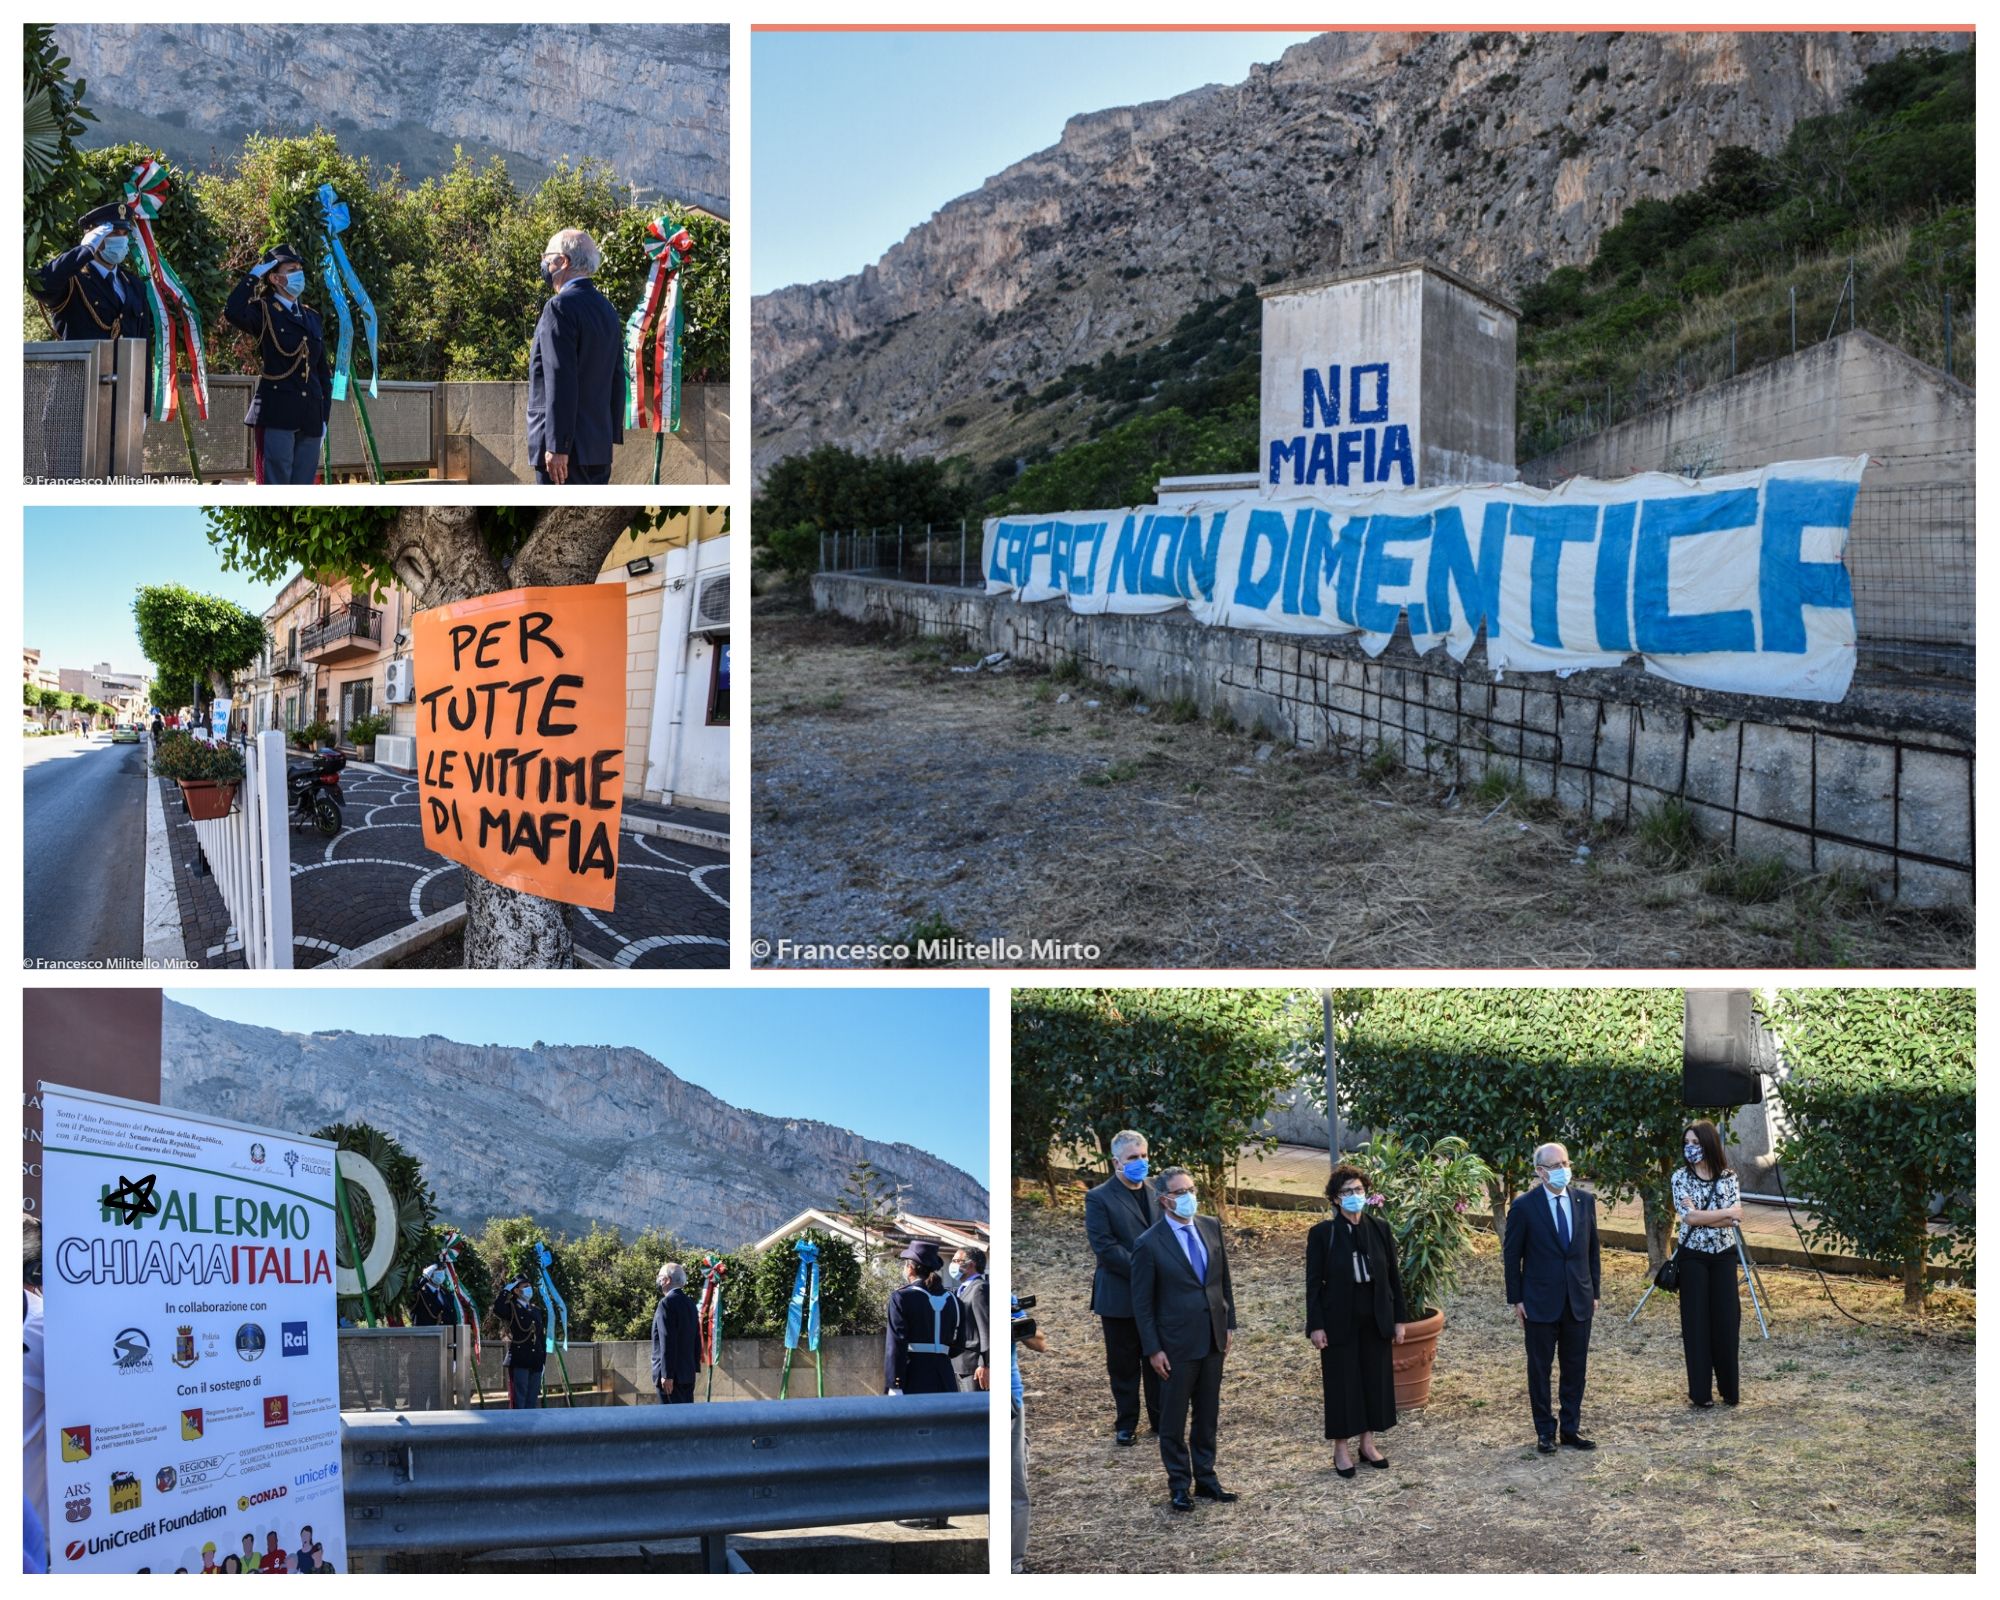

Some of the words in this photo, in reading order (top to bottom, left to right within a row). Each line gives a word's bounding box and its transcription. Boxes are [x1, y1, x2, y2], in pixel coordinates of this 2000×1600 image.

[1302, 362, 1390, 429] NO
[1269, 424, 1416, 487] MAFIA
[989, 520, 1108, 596] CAPACI
[1106, 511, 1229, 603] NON
[448, 611, 565, 672] PER
[420, 674, 584, 740] TUTTE
[424, 750, 458, 789] LE
[463, 748, 623, 810] VITTIME
[427, 796, 463, 842] DI
[479, 806, 616, 880] MAFIA
[56, 1109, 76, 1120] Sotto
[143, 1125, 176, 1138] Presidente
[56, 1121, 70, 1129] con
[71, 1122, 77, 1130] il
[79, 1124, 115, 1137] Patrocinio
[129, 1131, 152, 1143] Senato
[152, 1135, 168, 1145] della
[56, 1132, 70, 1140] con
[73, 1133, 79, 1142] il
[80, 1136, 116, 1148] Patrocinio
[301, 1163, 332, 1177] FALCONE
[165, 1302, 176, 1313] In
[178, 1301, 248, 1313] collaborazione
[250, 1302, 267, 1311] con
[283, 1330, 308, 1348] Rai
[119, 1360, 153, 1369] SAVONA
[177, 1384, 198, 1396] Con
[200, 1382, 207, 1393] il
[209, 1379, 250, 1393] sostegno
[253, 1376, 262, 1386] di
[95, 1426, 120, 1435] Regione
[180, 1457, 219, 1474] REGIONE
[294, 1463, 328, 1486] unicef
[63, 1482, 91, 1498] ARS
[180, 1472, 207, 1486] LAZIO
[113, 1491, 140, 1513] eni
[249, 1485, 288, 1506] CONAD
[88, 1522, 156, 1555] UniCredit
[158, 1505, 227, 1535] Foundation
